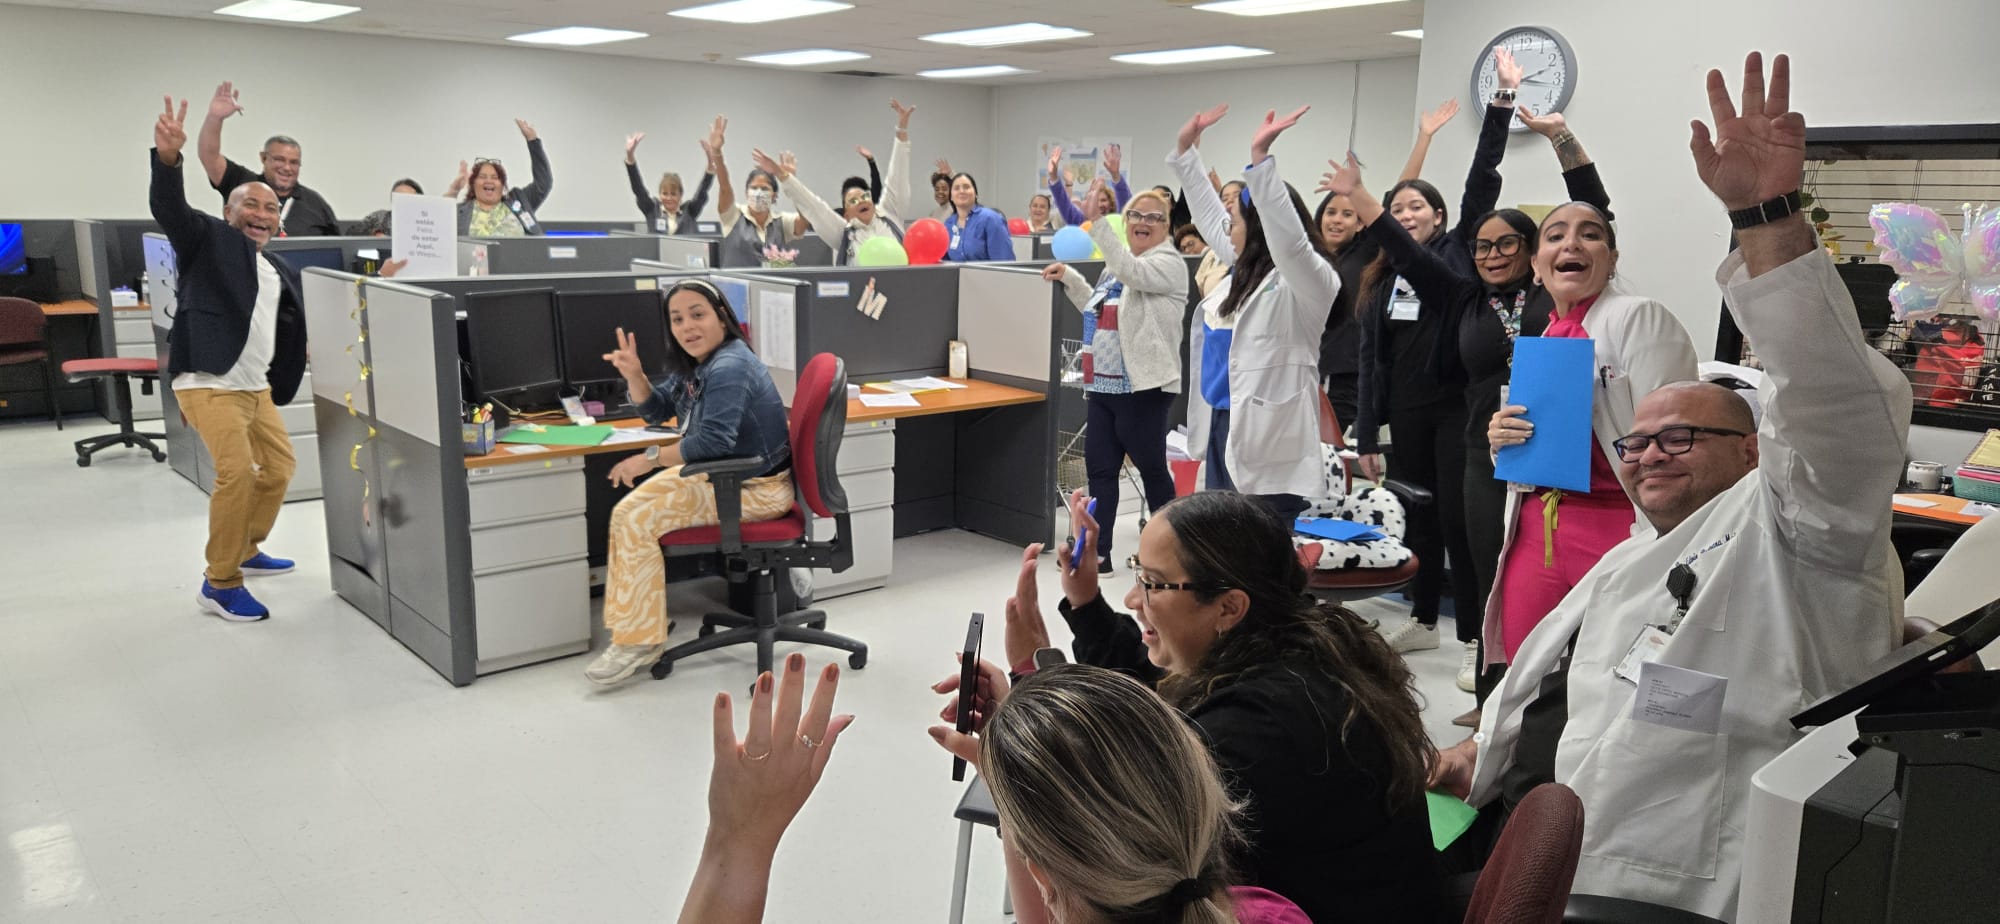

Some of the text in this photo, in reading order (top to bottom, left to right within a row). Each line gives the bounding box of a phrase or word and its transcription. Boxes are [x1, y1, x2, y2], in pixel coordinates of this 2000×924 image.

[1519, 37, 1533, 51] 12
[1540, 40, 1545, 54] 1
[1548, 53, 1557, 67] 2
[1485, 75, 1493, 89] 9
[1553, 72, 1561, 85] 3
[1544, 89, 1553, 103] 4
[1531, 104, 1540, 117] 5
